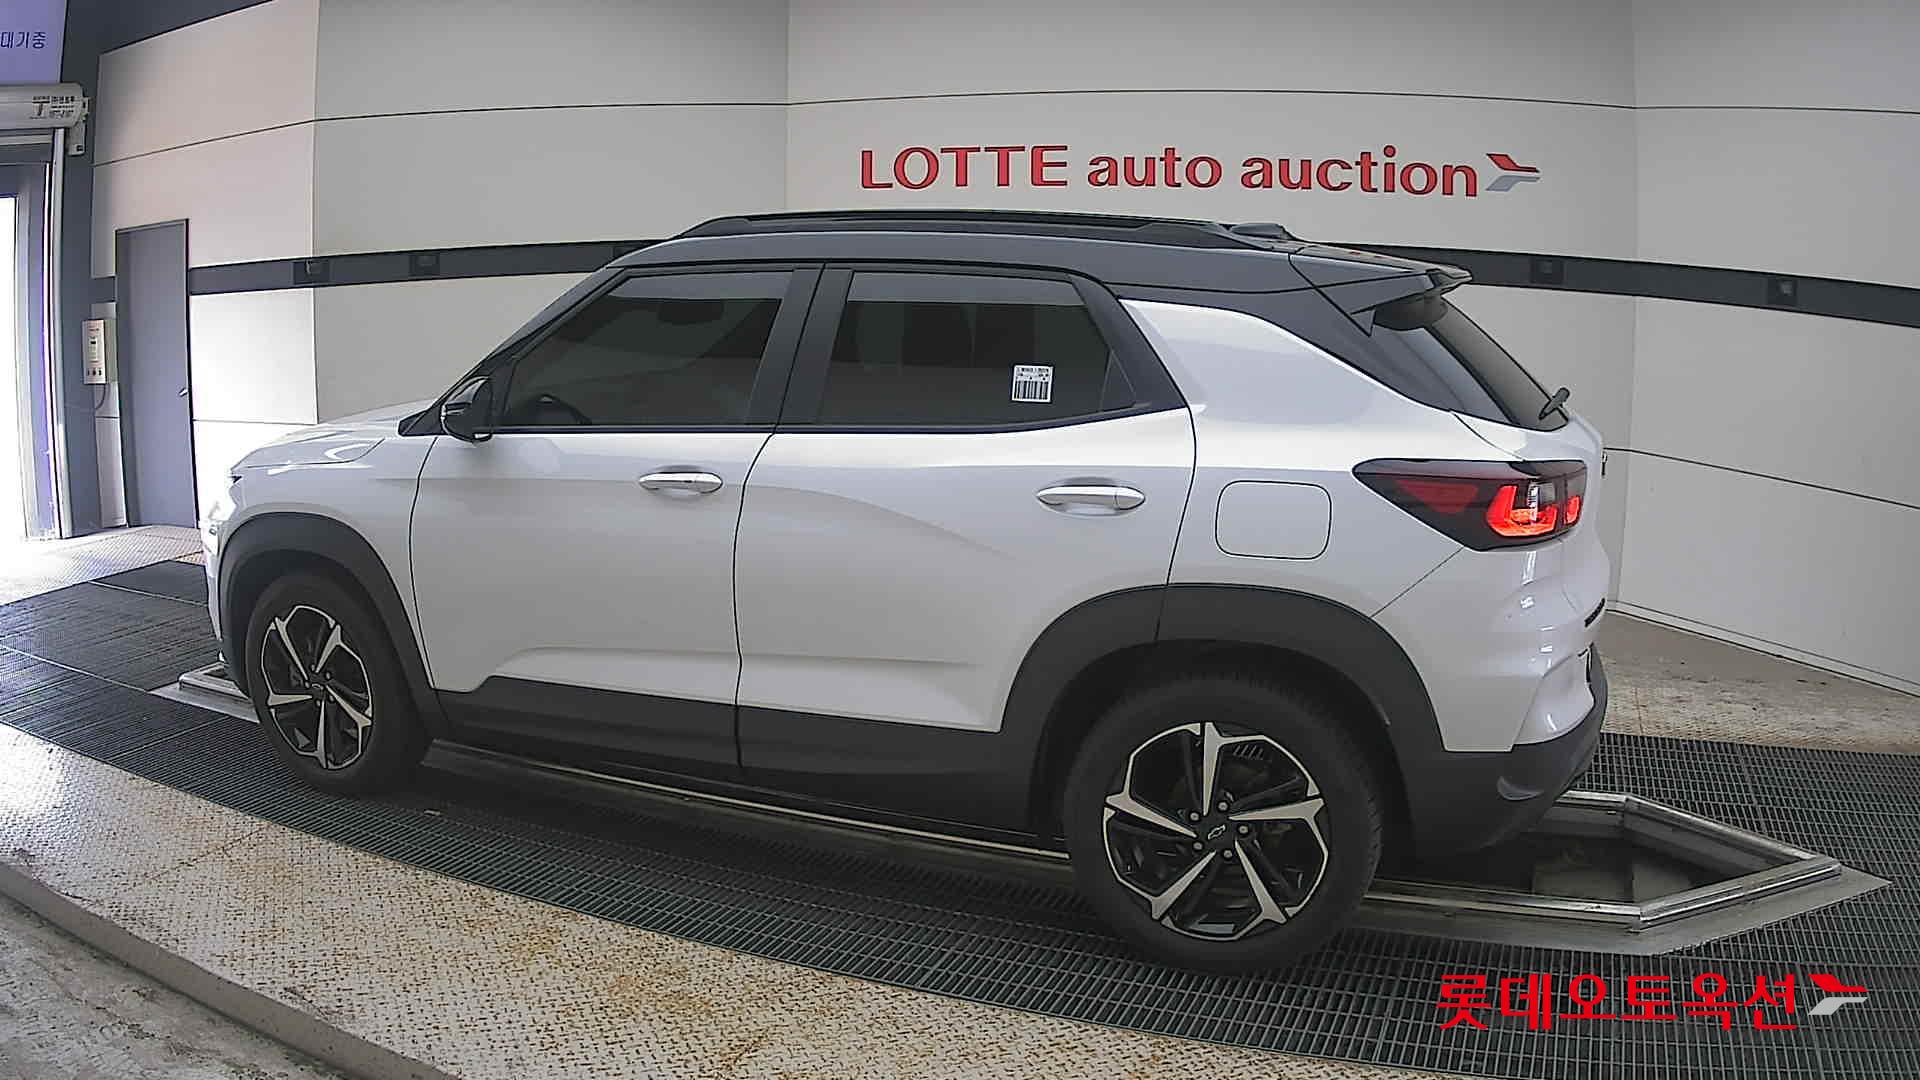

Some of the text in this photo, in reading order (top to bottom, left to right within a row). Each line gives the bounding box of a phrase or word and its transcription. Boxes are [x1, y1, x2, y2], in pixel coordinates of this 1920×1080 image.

[0, 31, 47, 49] 대기중
[861, 144, 1480, 198] LOTTE auto auction
